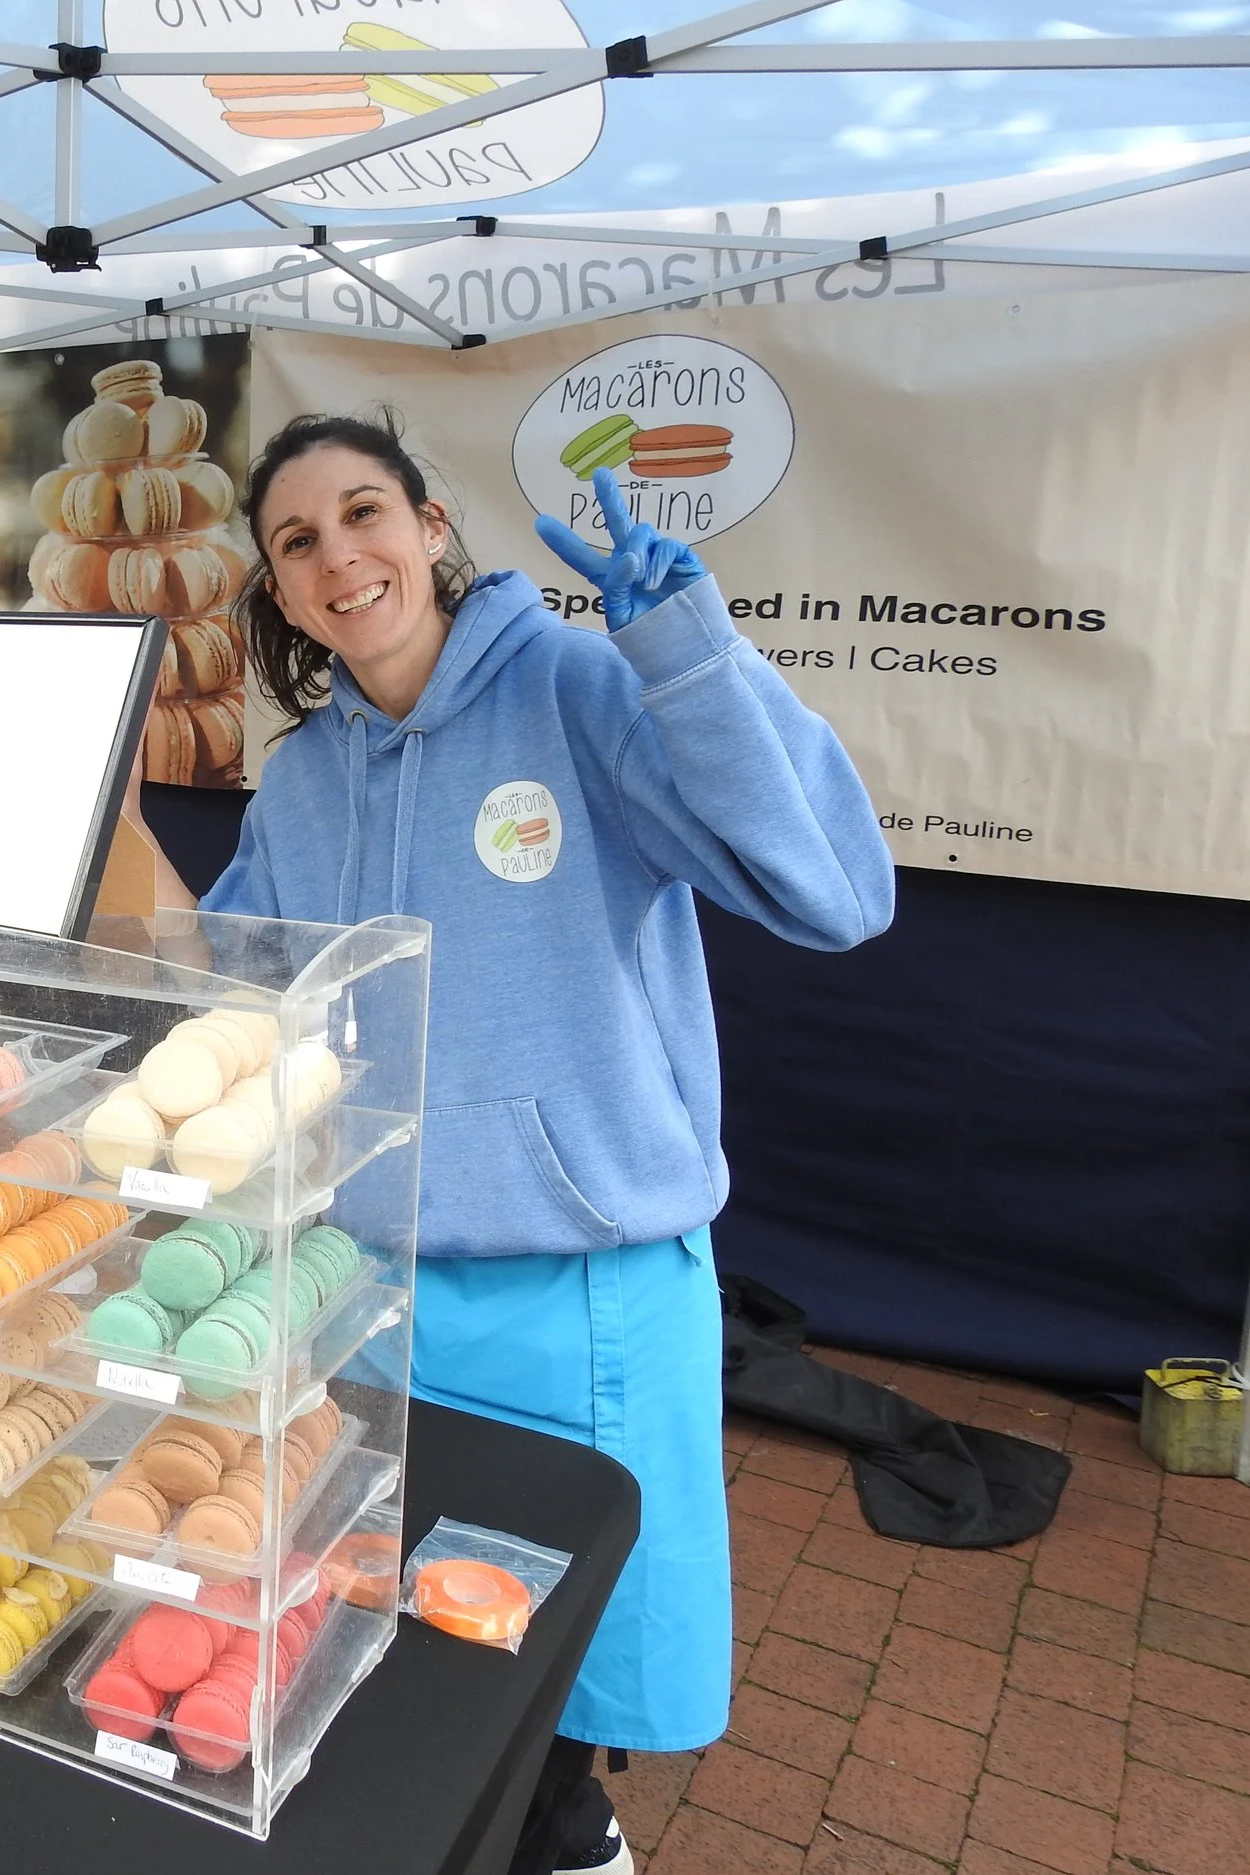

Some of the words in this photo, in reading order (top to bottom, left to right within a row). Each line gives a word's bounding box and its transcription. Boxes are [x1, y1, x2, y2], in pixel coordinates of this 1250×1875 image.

[638, 360, 663, 369] LES
[560, 367, 745, 413] Macarons
[629, 481, 650, 490] DE
[800, 593, 841, 621] in
[859, 594, 1107, 633] Macarons
[871, 646, 999, 676] Cakes
[483, 790, 548, 823] Macarons
[879, 812, 914, 831] de
[923, 815, 1033, 842] Pauline
[108, 1366, 155, 1394] Nutella
